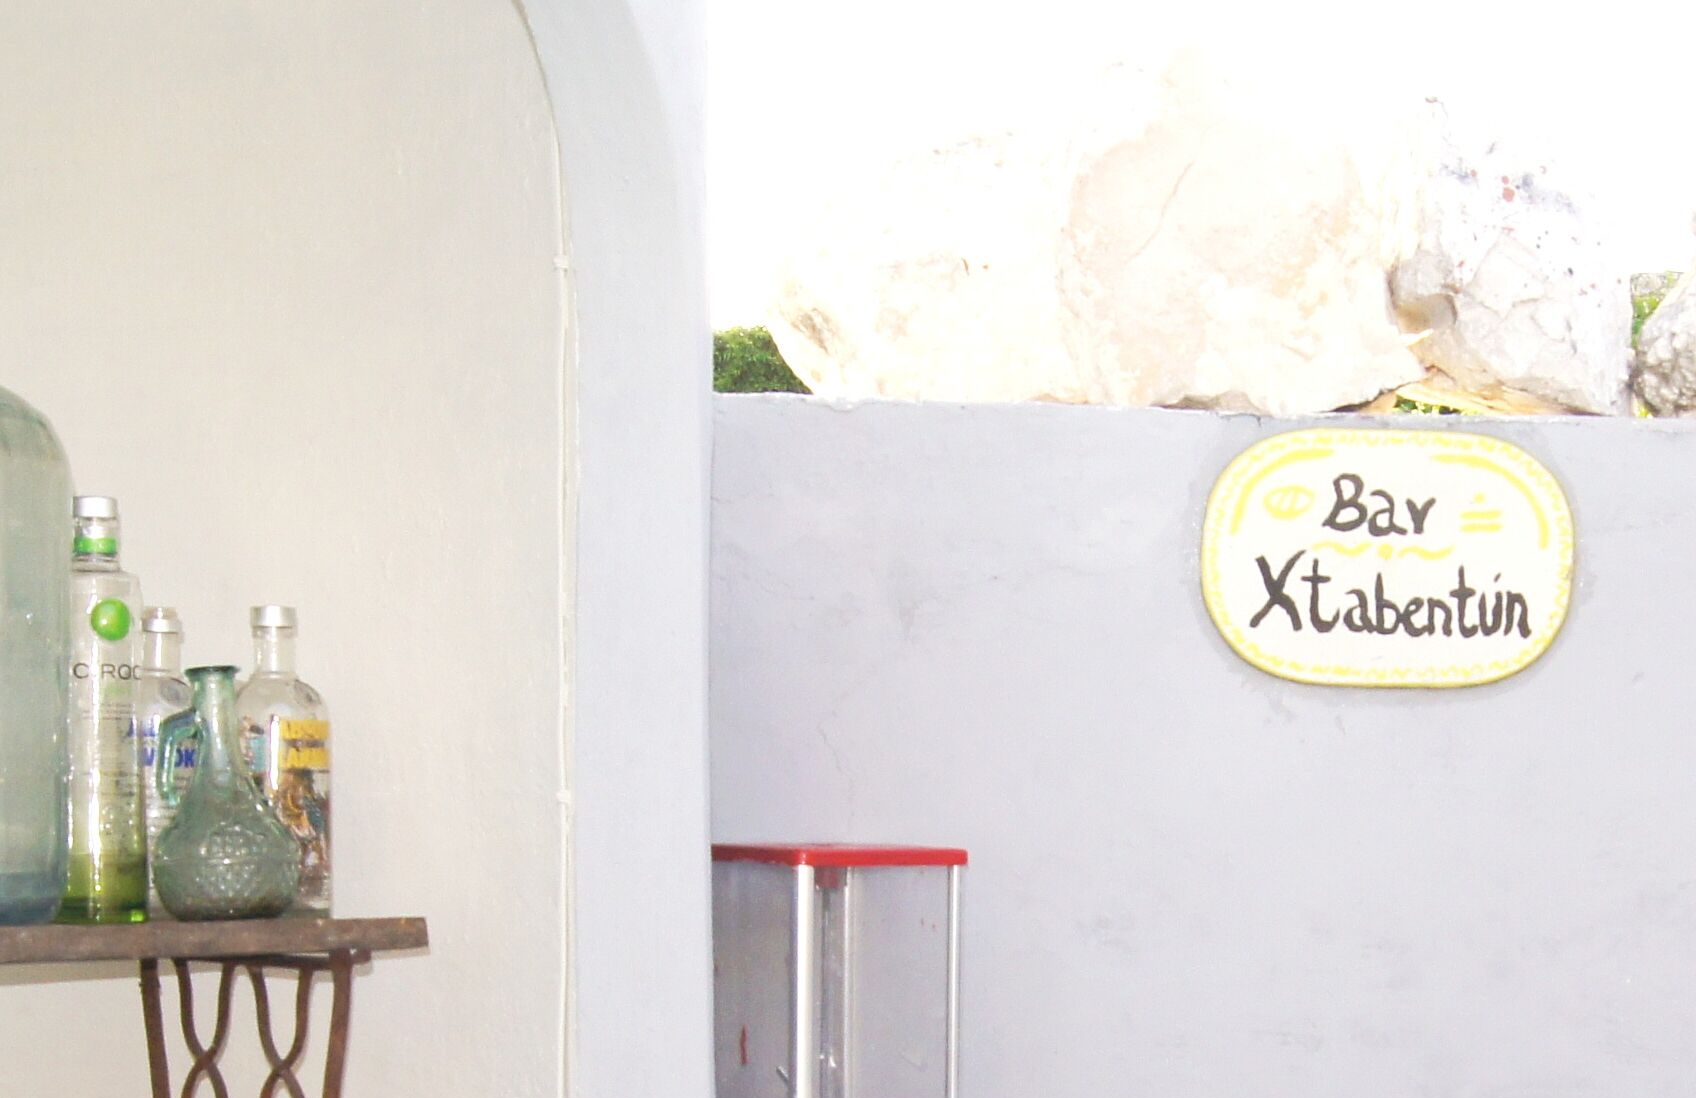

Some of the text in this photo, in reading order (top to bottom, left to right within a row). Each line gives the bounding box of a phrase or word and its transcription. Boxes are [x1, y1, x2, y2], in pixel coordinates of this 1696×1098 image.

[1321, 472, 1436, 538] Bar
[1249, 550, 1532, 638] Xtabentún
[73, 662, 142, 680] CROC
